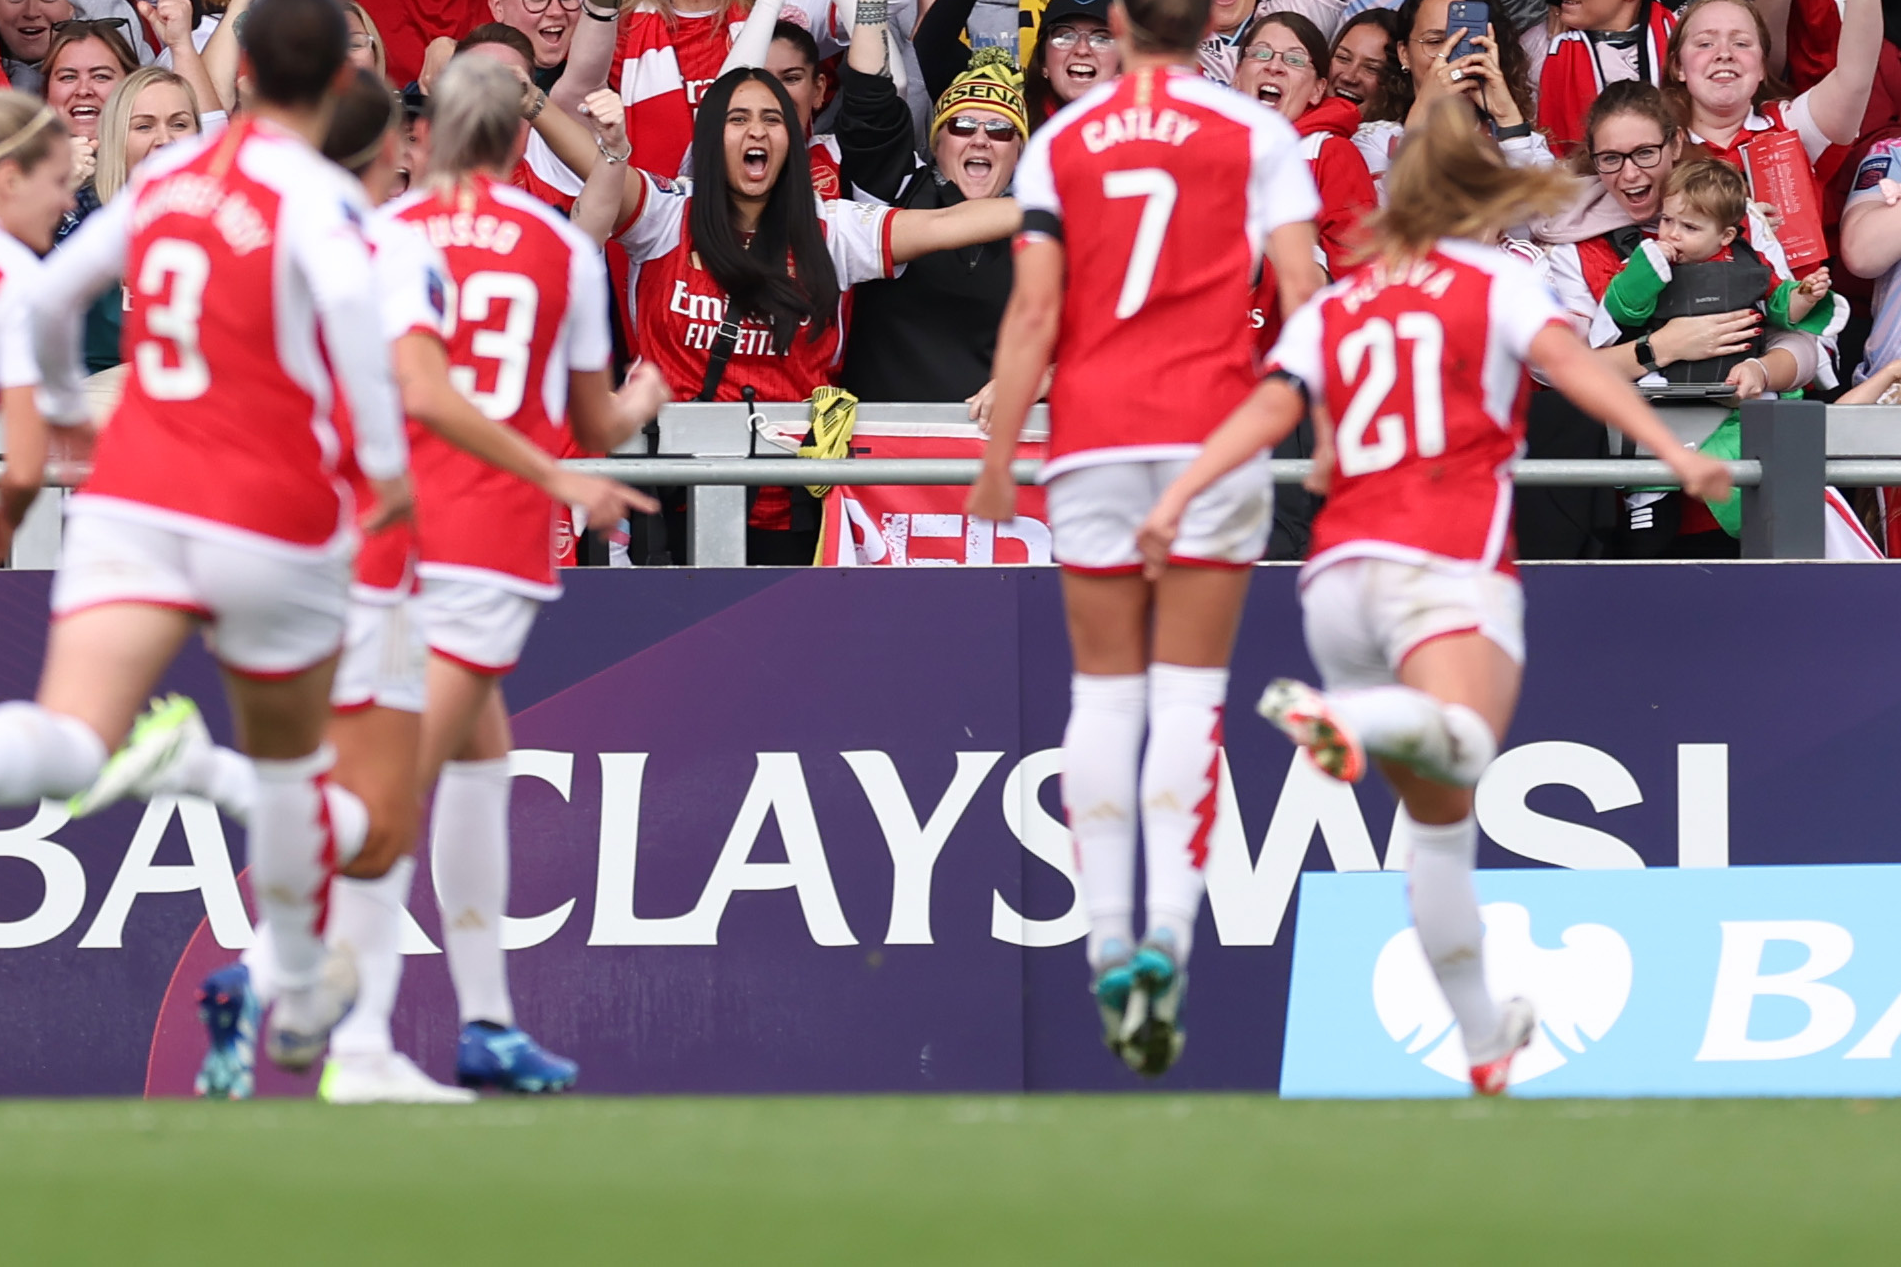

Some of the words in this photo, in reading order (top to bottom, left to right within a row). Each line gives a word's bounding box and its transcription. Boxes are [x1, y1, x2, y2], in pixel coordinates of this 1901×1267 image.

[1081, 105, 1202, 154] CATLEY
[422, 213, 524, 255] USSO
[1102, 168, 1178, 320] 7
[135, 238, 211, 401] 3
[684, 323, 719, 350] FLY
[1336, 311, 1446, 478] 21
